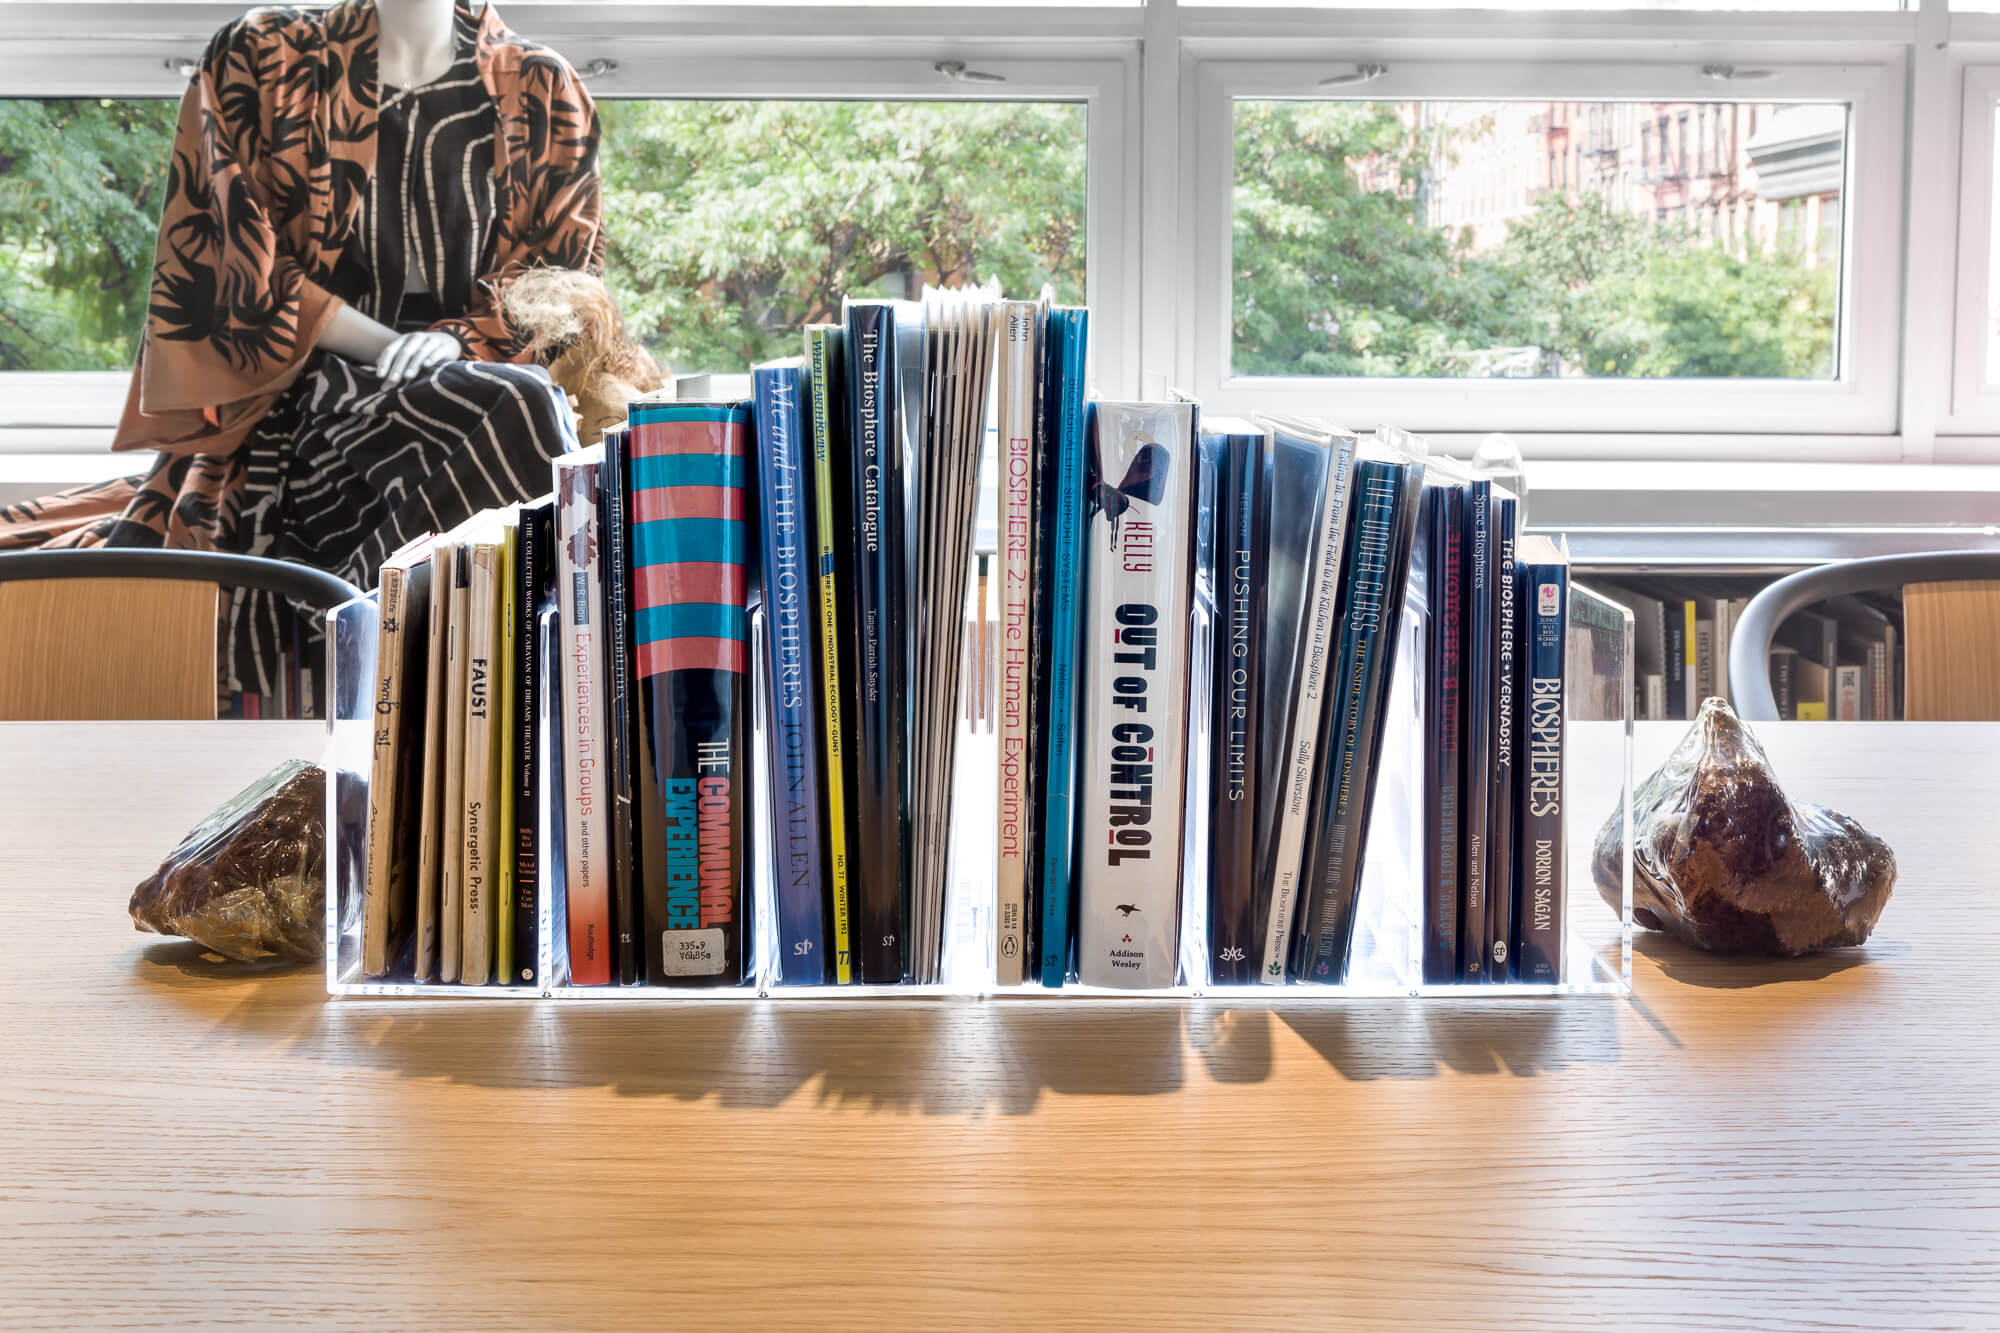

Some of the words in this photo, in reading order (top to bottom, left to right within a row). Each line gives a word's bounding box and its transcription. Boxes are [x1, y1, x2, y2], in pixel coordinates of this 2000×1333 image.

[862, 329, 878, 363] The
[1009, 315, 1020, 342] Allen
[1021, 316, 1031, 342] John
[812, 340, 823, 382] WHOLE
[769, 379, 793, 420] Me
[814, 383, 824, 420] EARTH
[860, 370, 879, 457] Biosphere
[1065, 379, 1079, 454] BIOLOGICAL
[770, 425, 796, 470] and
[815, 420, 826, 463] REVIEW
[1064, 455, 1075, 482] LIFE
[774, 477, 795, 536] THE
[863, 465, 881, 552] Catalogue
[1008, 437, 1029, 560] BIOSPHERE
[1239, 492, 1249, 536] NELSON
[1330, 499, 1343, 526] From
[1362, 477, 1395, 516] LIFE
[1475, 494, 1488, 525] Space
[611, 496, 622, 554] THEATER
[1062, 488, 1073, 545] SUPPORT
[1327, 528, 1340, 542] the
[525, 541, 533, 587] COLLECTED
[1123, 522, 1153, 573] KELLY
[1324, 544, 1338, 566] Field
[1356, 519, 1392, 573] UNDER
[1472, 530, 1487, 589] Biospheres
[1502, 538, 1514, 571] THE
[576, 575, 586, 585] W.
[613, 560, 623, 575] OF
[823, 546, 831, 590] BIERE
[1007, 569, 1027, 589] 2:
[1061, 553, 1072, 612] SYSTEMS
[1323, 569, 1334, 578] to
[525, 591, 533, 618] WORKS
[576, 589, 586, 597] R.
[614, 581, 624, 605] ALL
[825, 598, 832, 609] AT
[1231, 550, 1251, 658] PUSHING
[1320, 580, 1333, 595] the
[577, 600, 587, 621] Bion
[866, 609, 877, 636] Tango
[1006, 599, 1026, 640] The
[1316, 596, 1330, 631] Kitchen
[1349, 580, 1384, 633] GLASS
[1501, 575, 1514, 661] BIOSPHERE
[525, 621, 533, 632] OF
[777, 545, 803, 708] BIOSPHERES
[1113, 603, 1158, 671] OUT
[1315, 634, 1326, 643] in
[615, 610, 626, 699] POSSIBILITIES
[827, 635, 835, 683] INDUSTRIAL
[868, 639, 878, 669] Parrish
[1357, 639, 1368, 658] THE
[525, 676, 532, 686] OF
[572, 633, 593, 735] Experiences
[867, 672, 878, 702] Snyder
[1057, 664, 1068, 700] Nelson
[1307, 646, 1324, 691] Biosphere
[1350, 662, 1365, 698] INSIDE
[471, 659, 488, 720] FAUST
[524, 689, 532, 722] DREAMS
[1005, 648, 1025, 727] Human
[1112, 676, 1148, 713] OF
[1230, 668, 1247, 719] OUR
[1306, 692, 1317, 700] 2
[1346, 699, 1360, 732] STORY
[1499, 675, 1512, 767] VERNADSKY
[374, 728, 391, 760] The
[578, 739, 594, 753] in
[697, 738, 729, 774] THE
[781, 720, 805, 792] JOHN
[1296, 739, 1311, 765] Sally
[1345, 734, 1356, 749] OF
[1530, 677, 1561, 817] BIOSPHERES
[1228, 730, 1246, 802] LIMITS
[1338, 751, 1355, 808] BIOSPHERE
[575, 758, 595, 816] Groups
[1000, 738, 1024, 858] Experiment
[1108, 723, 1155, 867] CONTROL
[1290, 766, 1308, 815] Silverstone
[581, 821, 591, 836] and
[1337, 808, 1347, 816] 2
[467, 802, 481, 872] Synergetic
[581, 838, 591, 859] other
[665, 778, 699, 930] EXPERIENCE
[698, 777, 733, 929] COMMUNAL
[788, 800, 810, 888] ALLEN
[1471, 833, 1480, 857] Allen
[580, 860, 591, 888] papers
[838, 871, 844, 879] 77
[1282, 871, 1293, 887] THE
[1471, 860, 1480, 875] and
[1535, 840, 1552, 885] DORION
[838, 885, 846, 917] WINTER
[1277, 888, 1290, 930] BIOSPHERE
[1470, 879, 1480, 908] Nelson
[1534, 889, 1552, 930] SAGAN
[586, 923, 596, 961] Routledge
[679, 941, 706, 950] 335.9
[1110, 950, 1144, 958] Addison
[1112, 960, 1141, 970] Wesley
